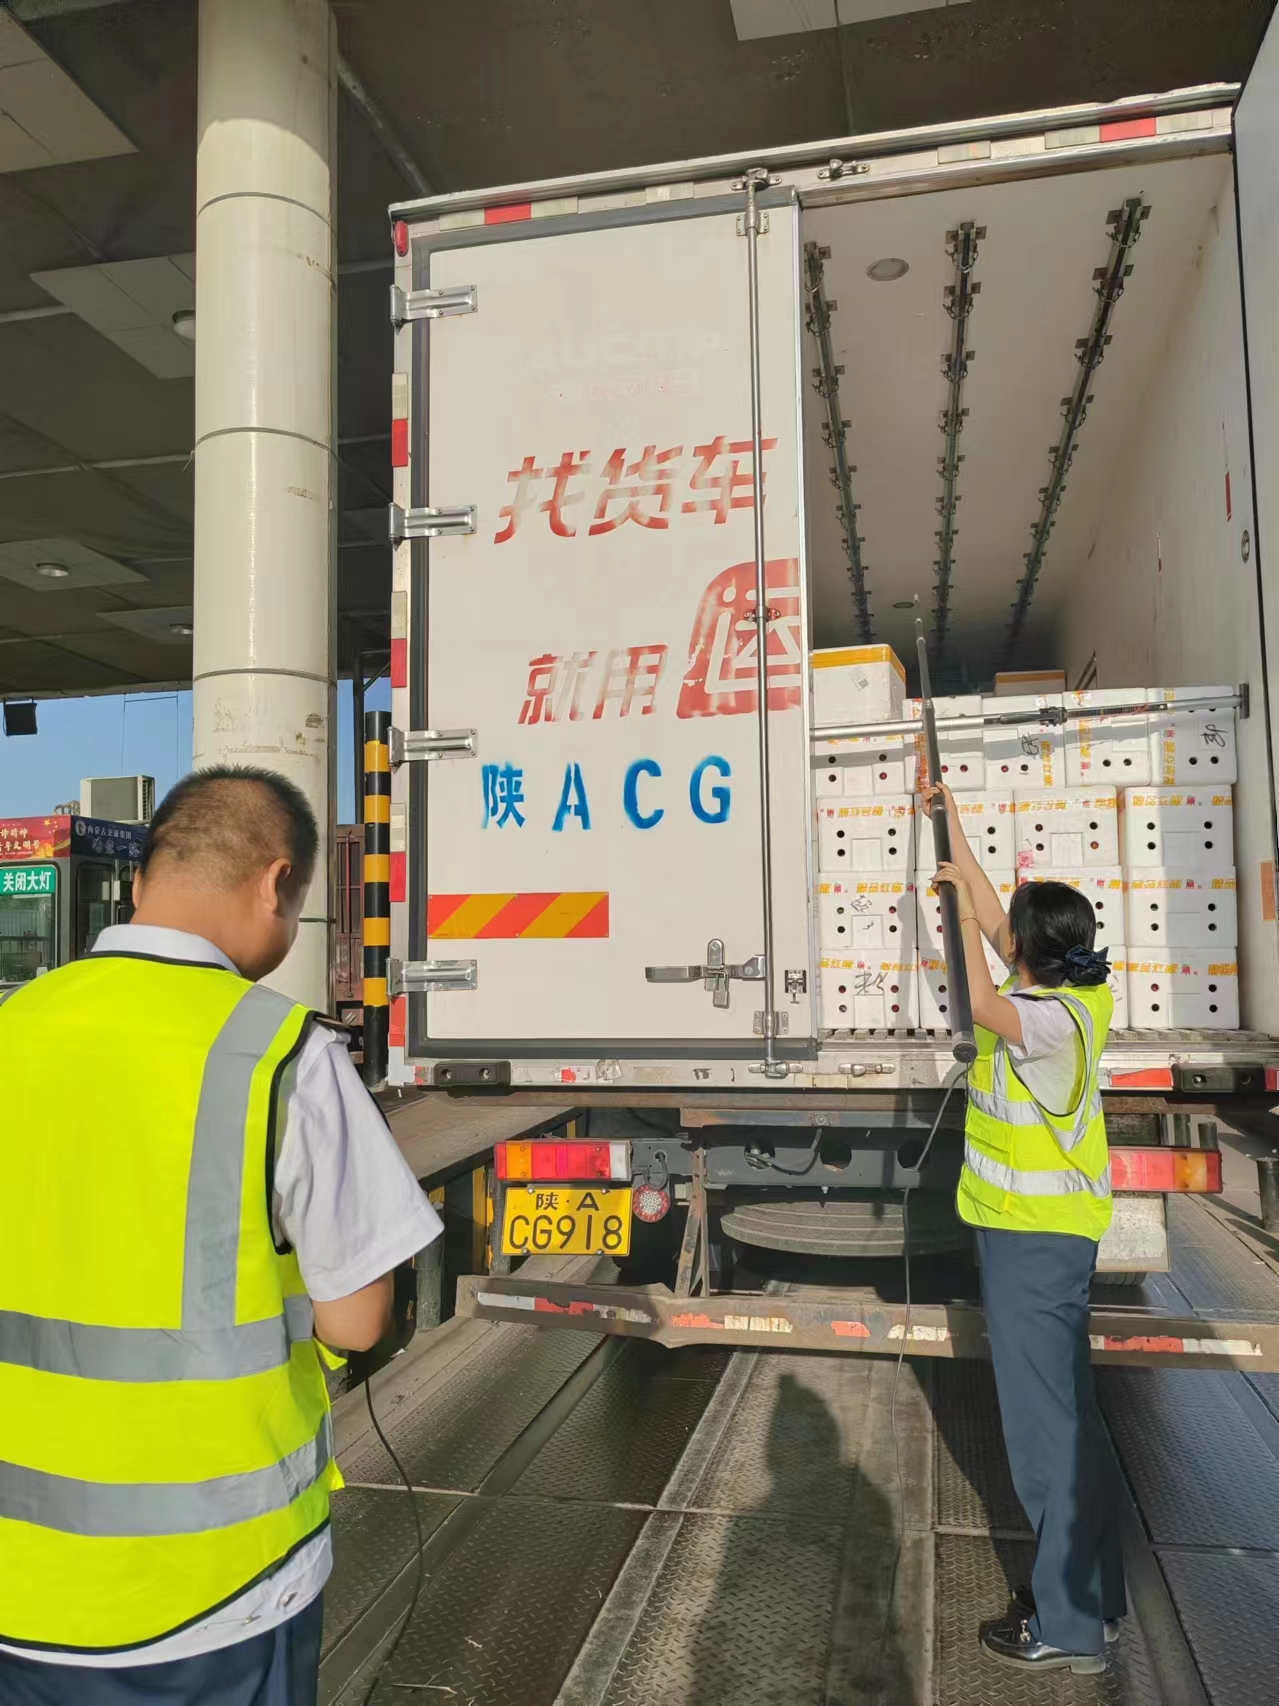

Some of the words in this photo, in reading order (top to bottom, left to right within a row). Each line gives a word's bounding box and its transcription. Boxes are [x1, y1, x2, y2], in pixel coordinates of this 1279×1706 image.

[494, 435, 778, 544] 找货车
[3, 871, 52, 892] 关闭大灯
[510, 1215, 623, 1250] CG918
